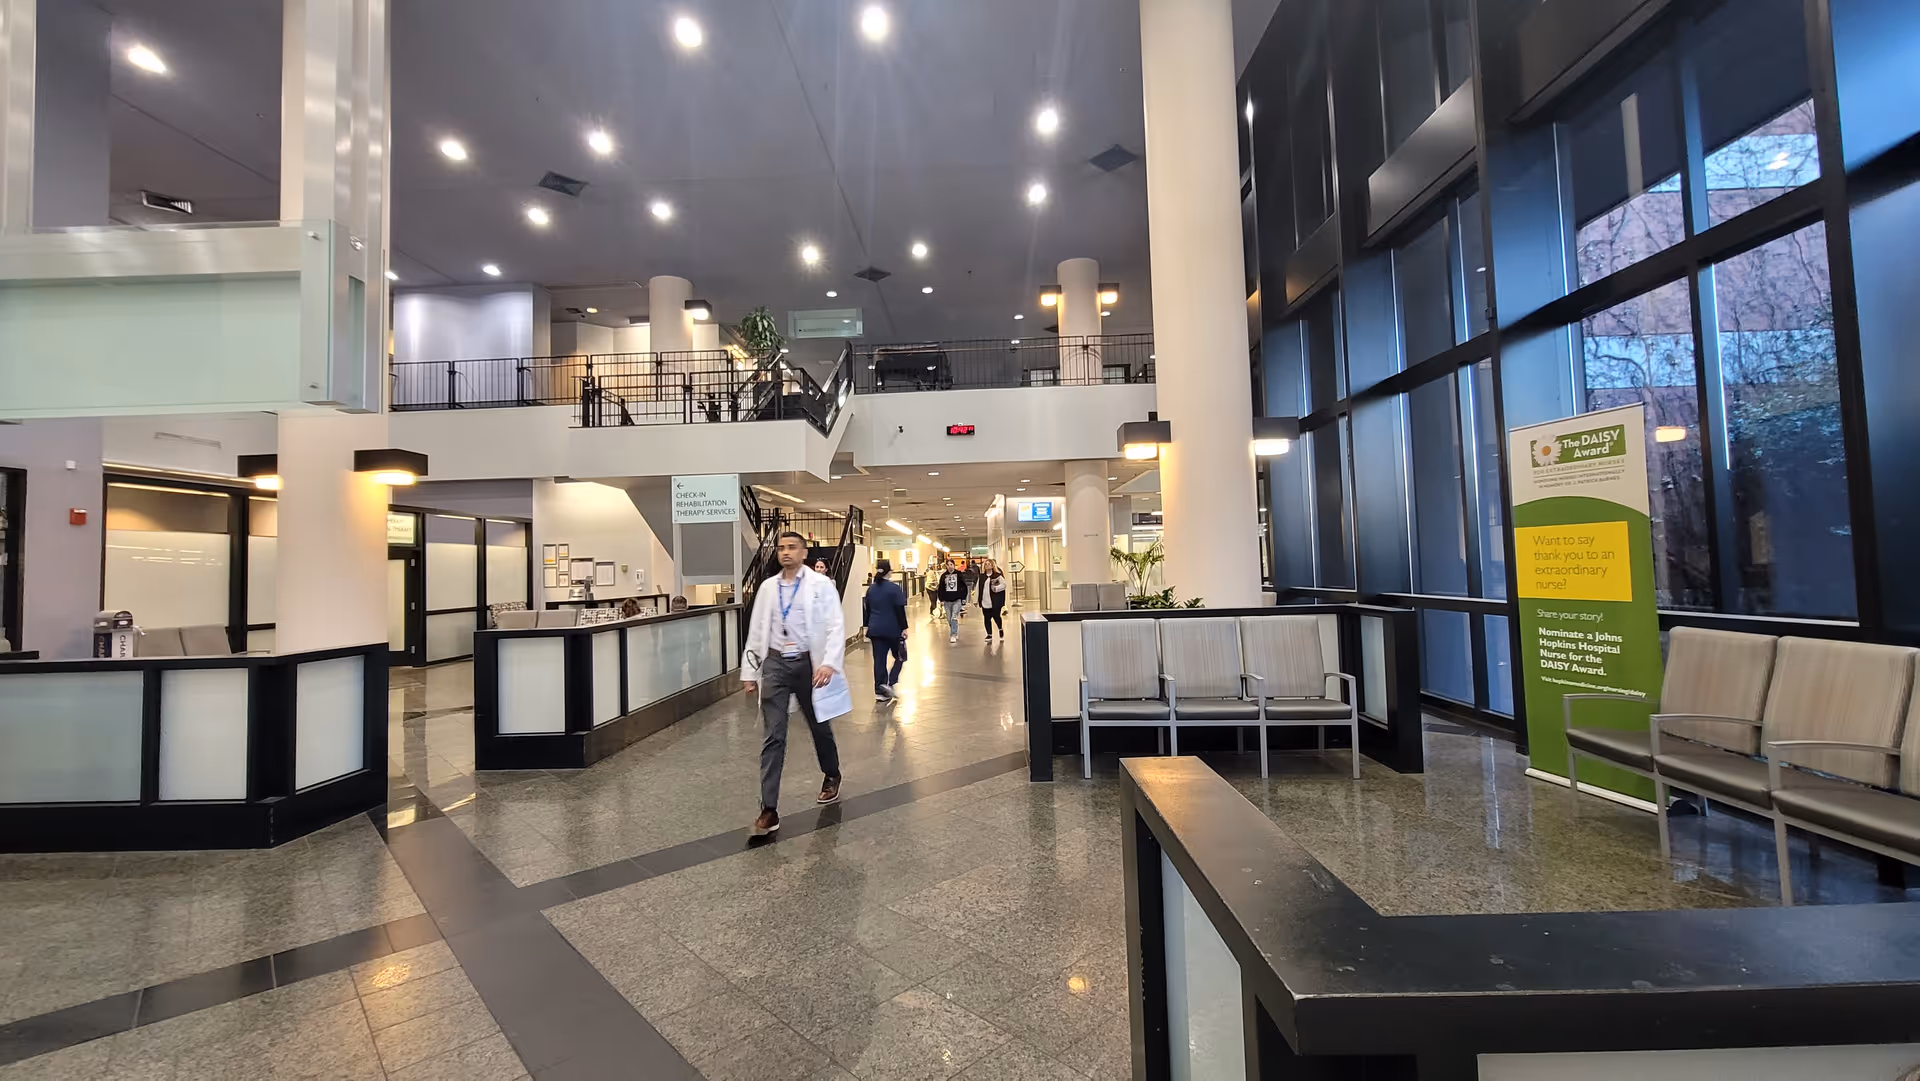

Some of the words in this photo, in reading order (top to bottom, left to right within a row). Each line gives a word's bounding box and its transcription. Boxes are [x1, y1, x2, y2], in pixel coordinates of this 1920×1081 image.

[1562, 439, 1580, 448] The
[1581, 429, 1620, 446] DAISY
[1546, 462, 1597, 473] EXTRAORDINARY
[1599, 458, 1625, 467] NURSES
[676, 500, 727, 508] REHABILITATION
[1533, 535, 1561, 546] Want
[1564, 536, 1575, 545] to
[1578, 536, 1595, 547] say
[1534, 551, 1562, 561] thank
[1564, 552, 1584, 562] you
[1586, 550, 1598, 560] to
[1602, 551, 1615, 560] an
[1535, 564, 1608, 578] extraordinary
[1536, 578, 1567, 590] nurse?
[1537, 609, 1558, 618] Share
[1559, 612, 1577, 621] your
[1580, 612, 1604, 623] story!
[1539, 627, 1584, 639] Nominate
[1595, 632, 1623, 642] Johns
[1540, 638, 1576, 650] Hopkins
[1579, 642, 1620, 654] Hospital
[1540, 649, 1566, 660] Nurse
[1569, 652, 1583, 662] for
[1585, 654, 1602, 664] the
[1541, 660, 1570, 671] DAISY
[1572, 664, 1607, 676] Award.
